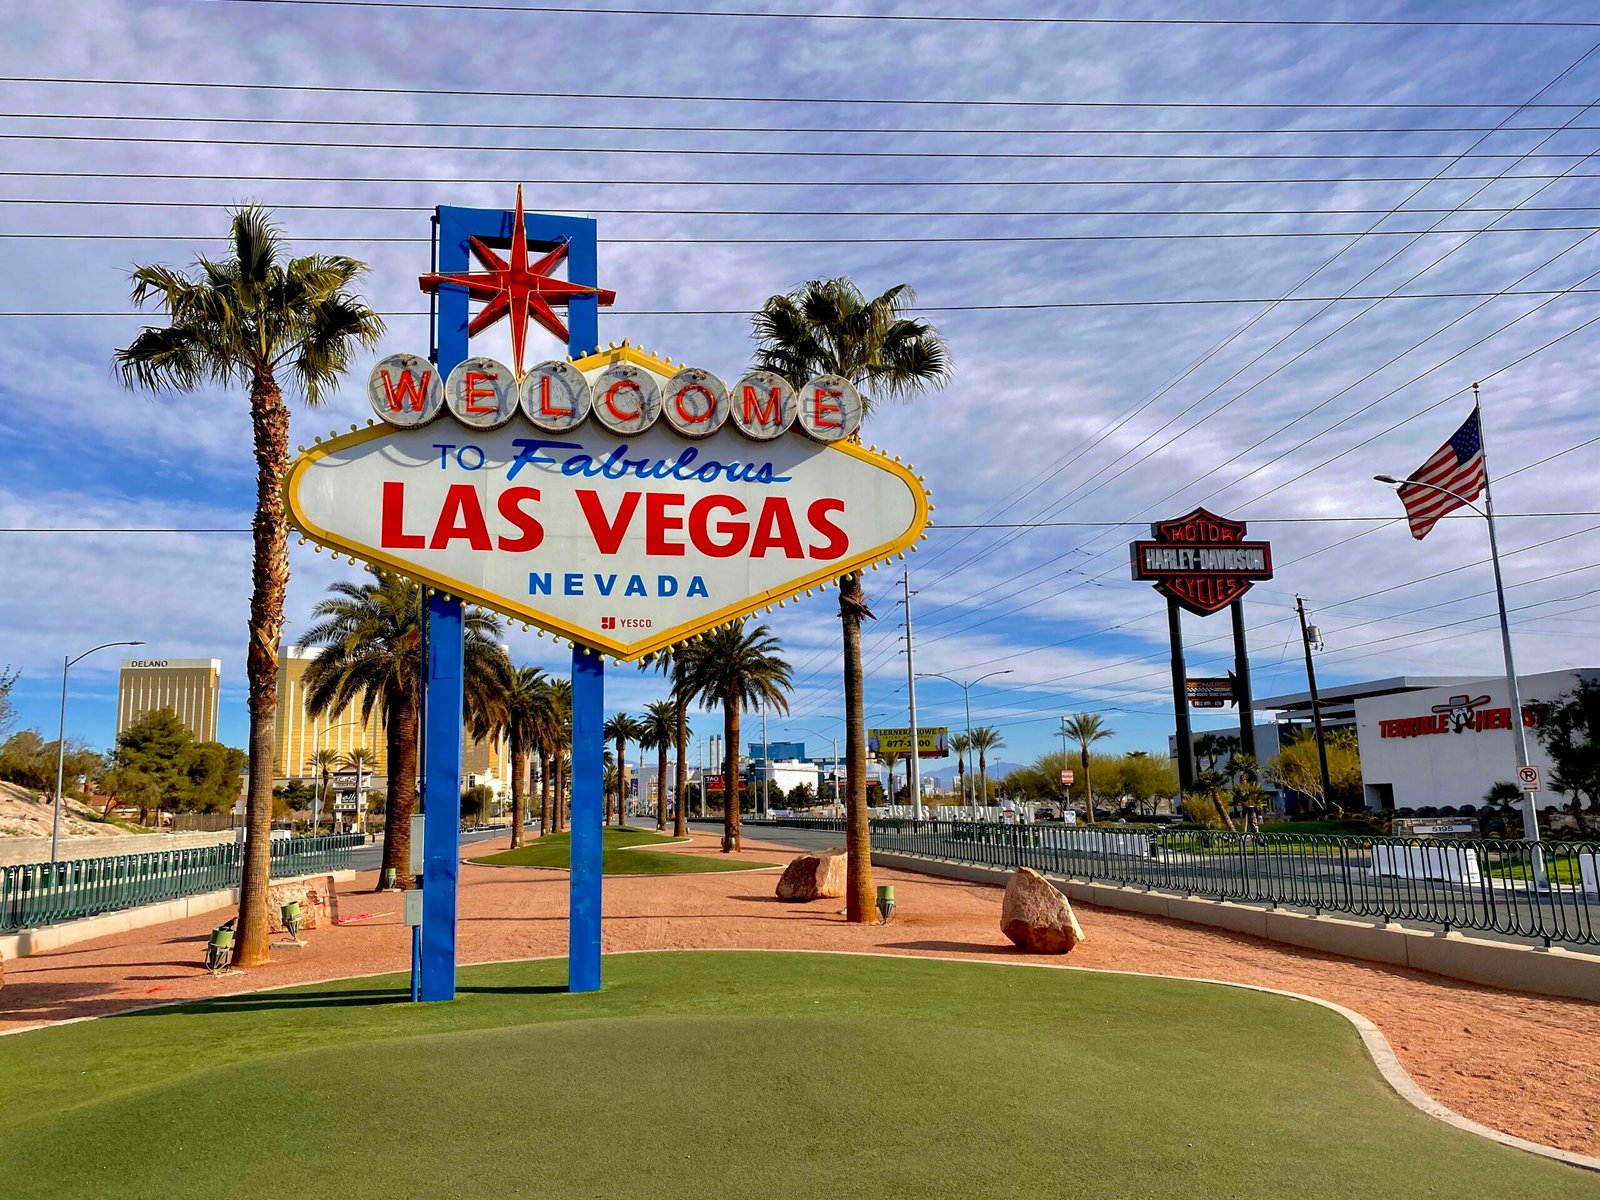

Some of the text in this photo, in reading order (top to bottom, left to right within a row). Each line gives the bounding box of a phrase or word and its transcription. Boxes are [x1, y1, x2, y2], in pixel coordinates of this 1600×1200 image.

[380, 369, 842, 428] WELCOME
[432, 438, 793, 485] TO Fabulous
[380, 481, 850, 561] LAS VEGAS
[1172, 520, 1233, 541] MOTOR
[1145, 548, 1266, 571] HARLEY-DAVIDSON
[529, 572, 709, 598] NEVADA
[1175, 578, 1238, 605] CYCLES
[131, 660, 168, 668] DELANO
[879, 728, 908, 736] LERNER
[1379, 713, 1449, 738] TERRIBLE
[887, 739, 930, 747] 877-100
